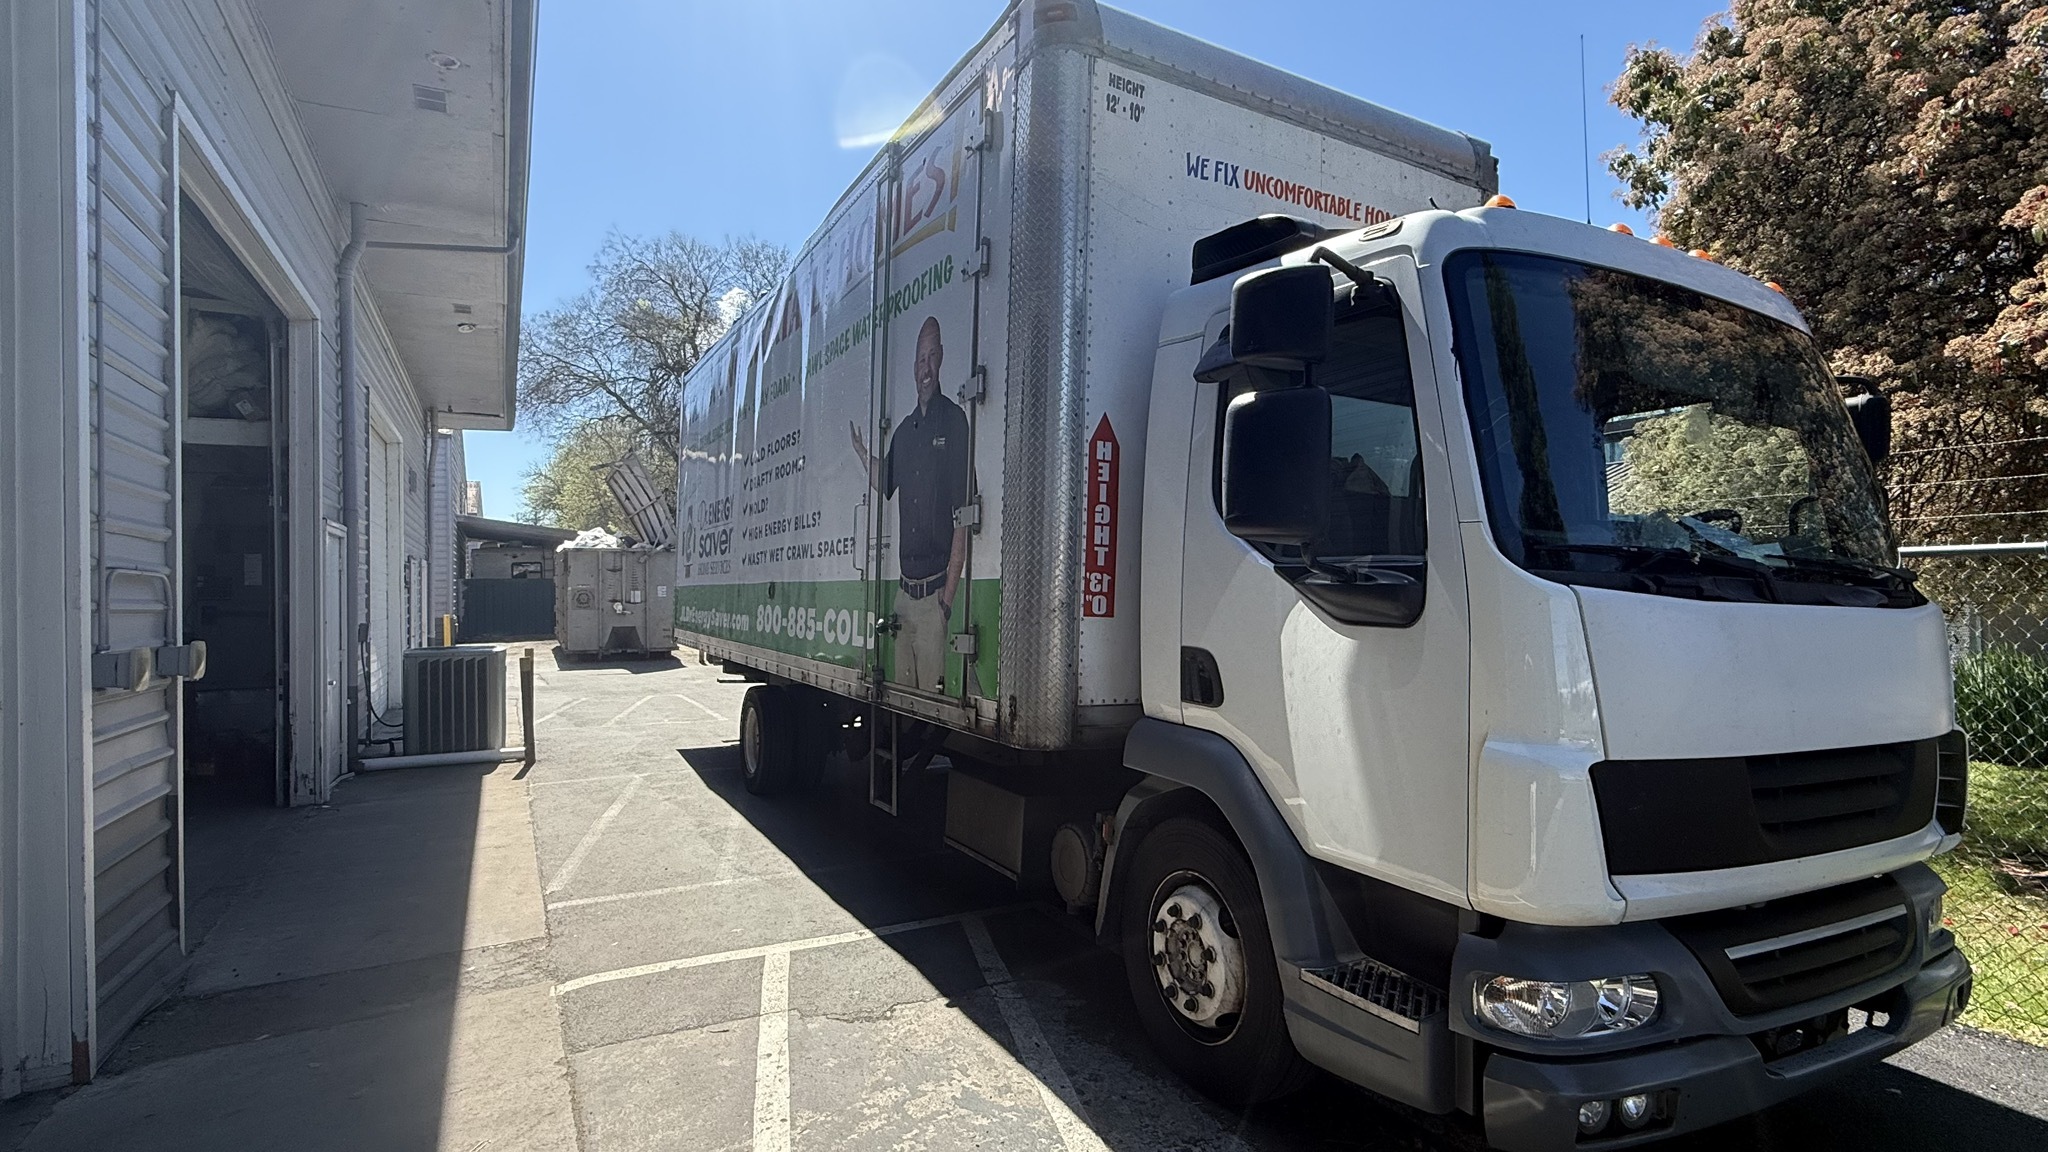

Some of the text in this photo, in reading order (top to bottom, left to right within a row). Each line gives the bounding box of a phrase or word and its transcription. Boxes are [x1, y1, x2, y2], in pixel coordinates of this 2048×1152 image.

[1109, 72, 1145, 99] HEIGHT
[1105, 93, 1121, 112] 12'
[1129, 102, 1146, 123] 10"
[1186, 152, 1210, 181] WE
[1214, 160, 1240, 189] FIX
[1244, 168, 1362, 222] UNCOMFORTABLE
[824, 327, 850, 366] SPACE
[750, 446, 766, 467] CLD
[767, 429, 801, 458] FLOORS?
[709, 494, 735, 525] ENERGY
[748, 510, 822, 541] HIGH ENERGY BILLS?
[698, 526, 734, 558] saver
[747, 550, 768, 566] NASTY
[769, 545, 785, 563] WET
[786, 543, 815, 561] CRAWL
[817, 536, 855, 558] SPACE?
[756, 604, 875, 649] 800-885-COLD
